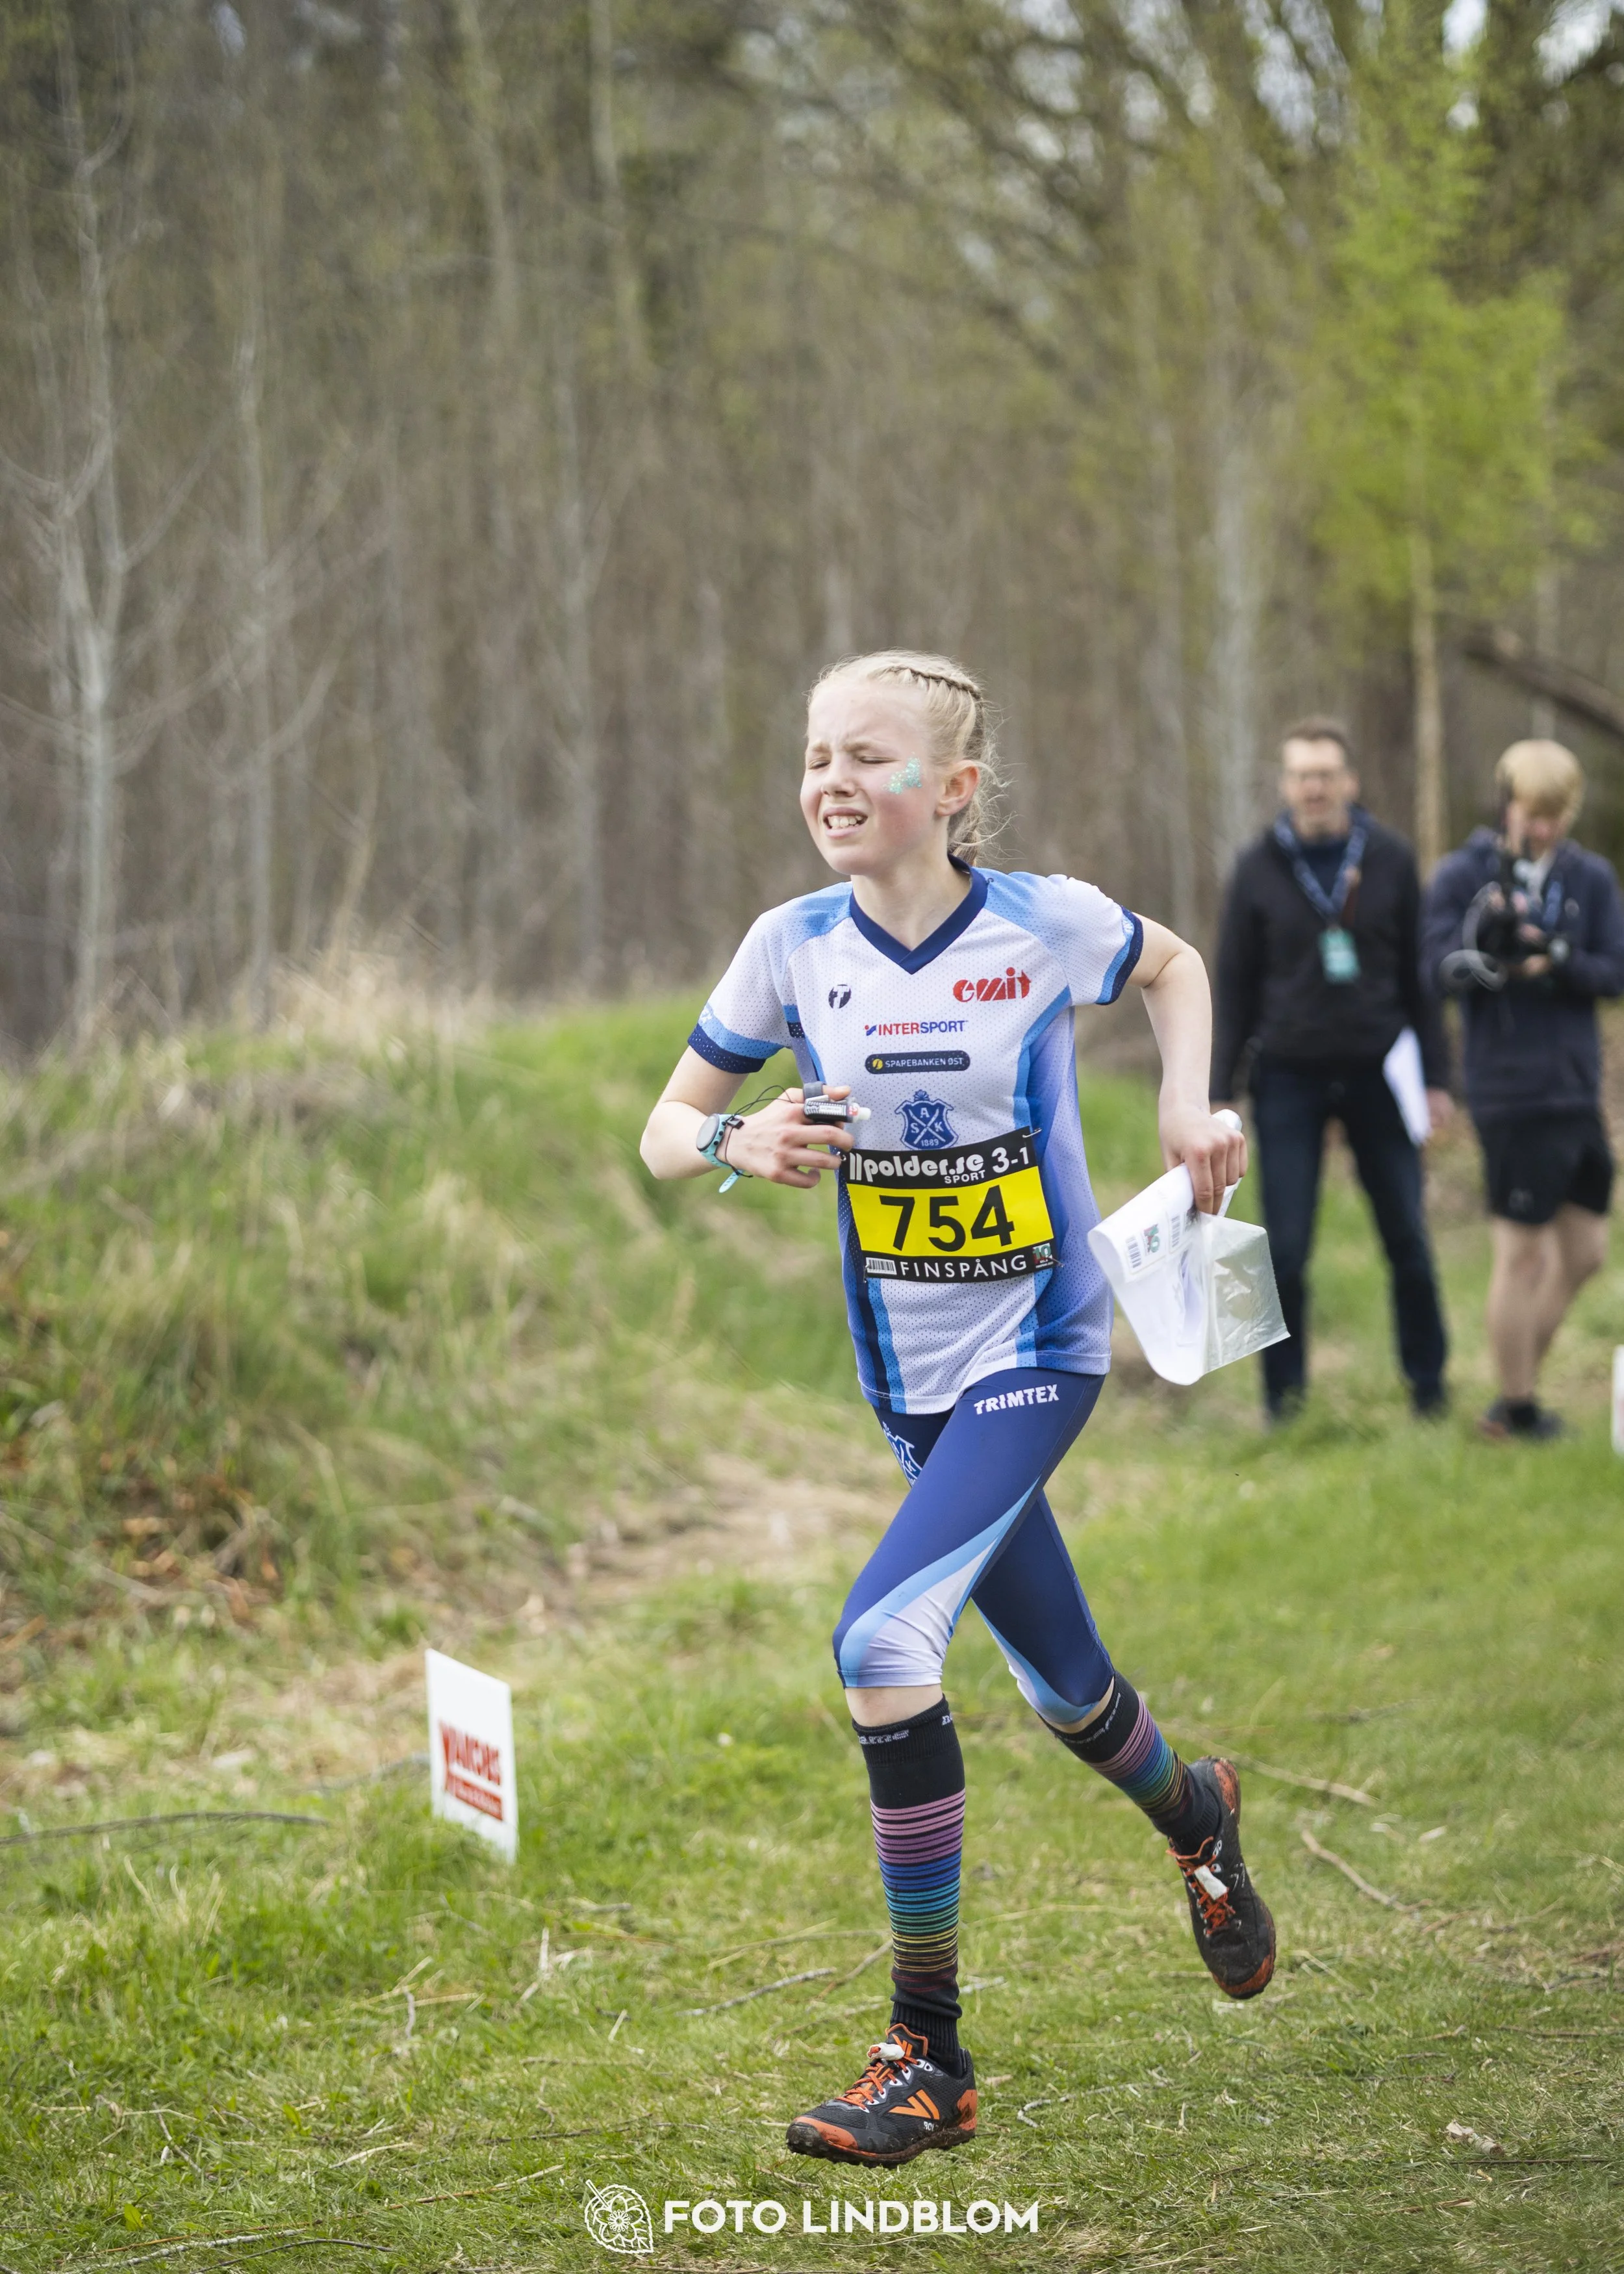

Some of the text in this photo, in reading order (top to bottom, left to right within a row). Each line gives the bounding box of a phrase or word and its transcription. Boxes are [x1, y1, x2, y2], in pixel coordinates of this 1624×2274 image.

[953, 967, 1031, 1003] emit
[878, 1021, 965, 1036] INTERSPORT
[885, 1058, 946, 1067] SPAREBANKEN
[991, 1147, 1029, 1173] 3-1
[944, 1169, 985, 1184] SPORT
[879, 1185, 1015, 1252] 754
[900, 1255, 1027, 1278] FINSPÅNG
[974, 1384, 1059, 1415] TRIMTEX
